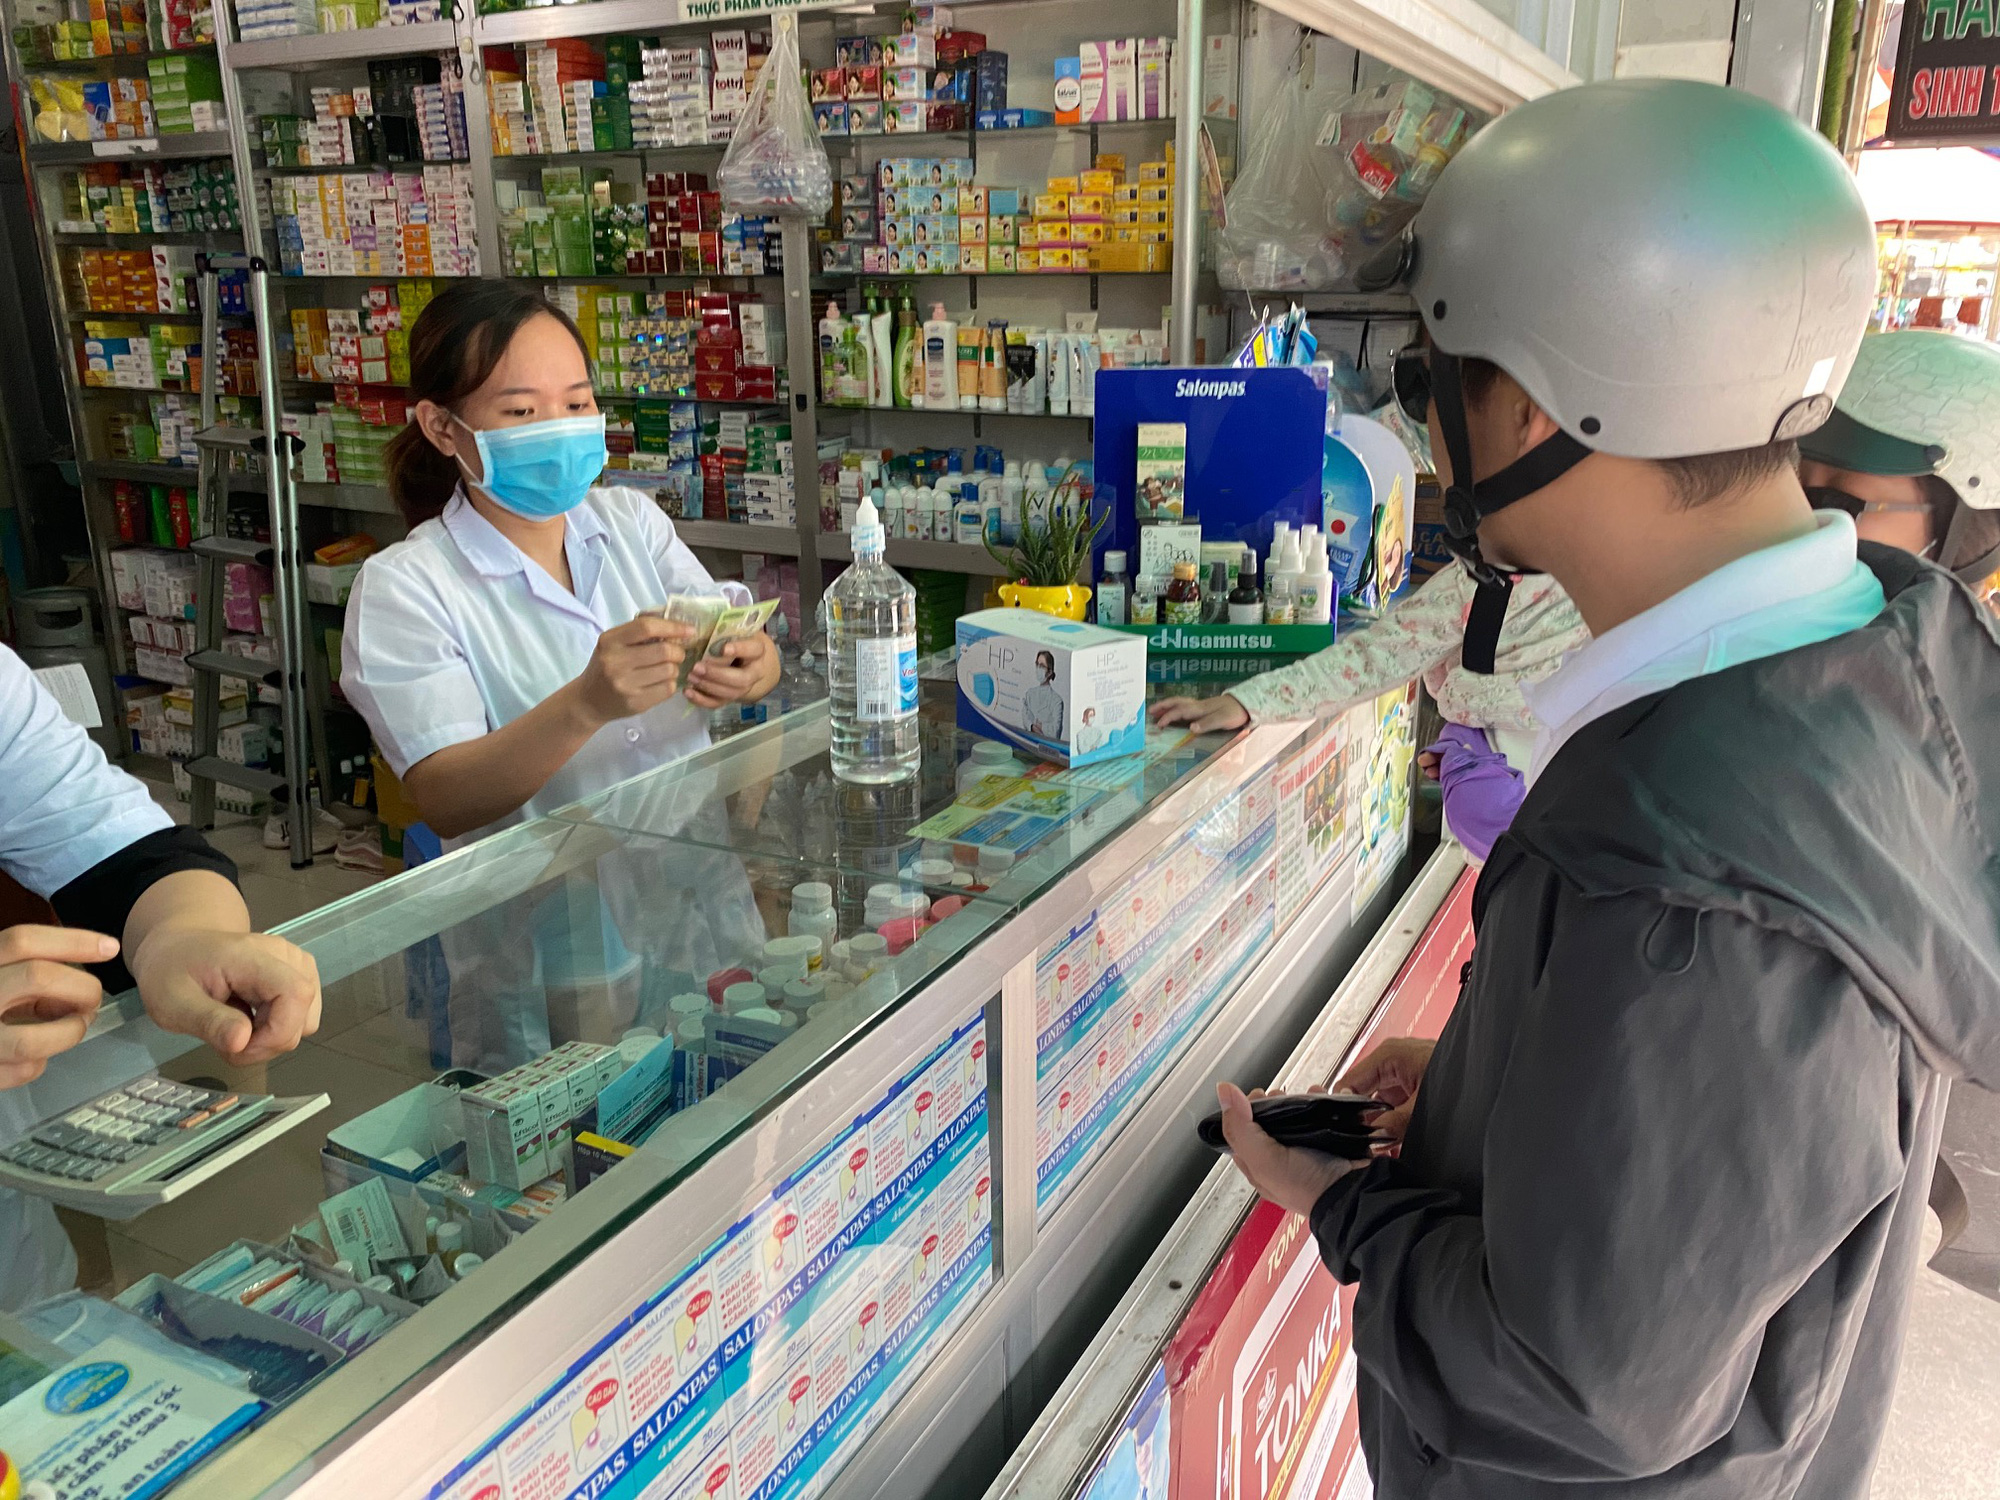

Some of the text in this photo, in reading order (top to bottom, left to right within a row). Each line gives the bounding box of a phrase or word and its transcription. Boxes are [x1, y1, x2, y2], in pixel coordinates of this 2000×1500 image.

[1909, 65, 1986, 119] SINH
[1175, 379, 1246, 400] Salonpas
[989, 645, 1014, 669] HP
[1095, 652, 1115, 668] HP
[1150, 628, 1272, 649] Hisamitsu
[1072, 978, 1107, 1021] SALONPAS
[876, 1092, 986, 1216] SALONPAS SALONPAS
[807, 1208, 870, 1284] SALONPAS
[724, 1278, 802, 1362] SALONPAS
[817, 1357, 878, 1439] SALONPAS
[885, 1287, 938, 1360] SALONPAS
[942, 1227, 990, 1293] SALONPAS
[633, 1357, 718, 1458] SALONPAS
[1255, 1284, 1341, 1499] TONKA
